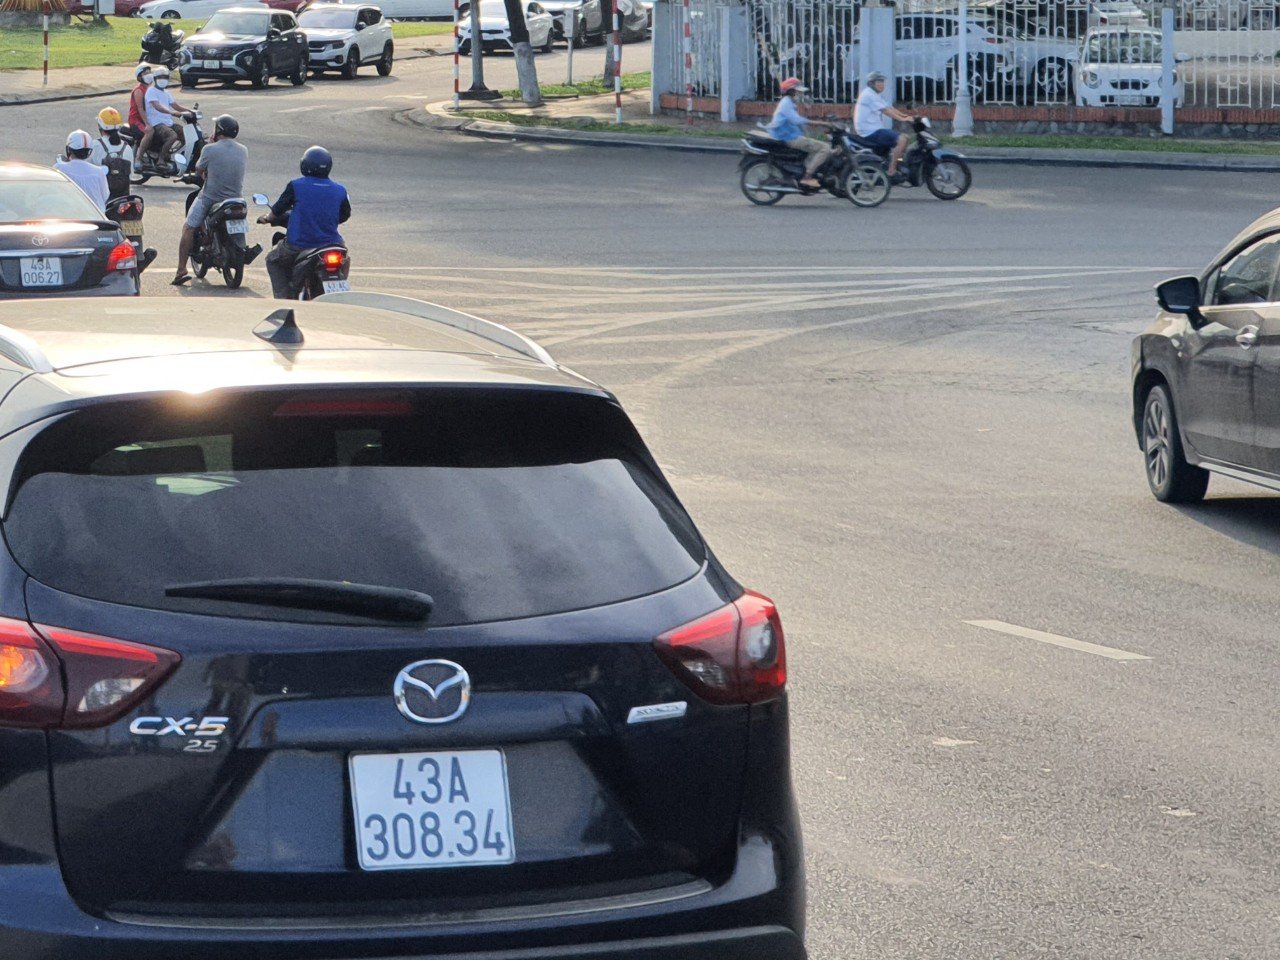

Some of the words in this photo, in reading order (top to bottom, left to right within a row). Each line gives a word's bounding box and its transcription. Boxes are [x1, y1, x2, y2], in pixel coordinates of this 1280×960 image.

[31, 258, 51, 270] 43A
[24, 271, 60, 284] 006.27
[129, 716, 230, 736] CX-5
[393, 756, 469, 805] 43A
[364, 808, 505, 861] 308.34
